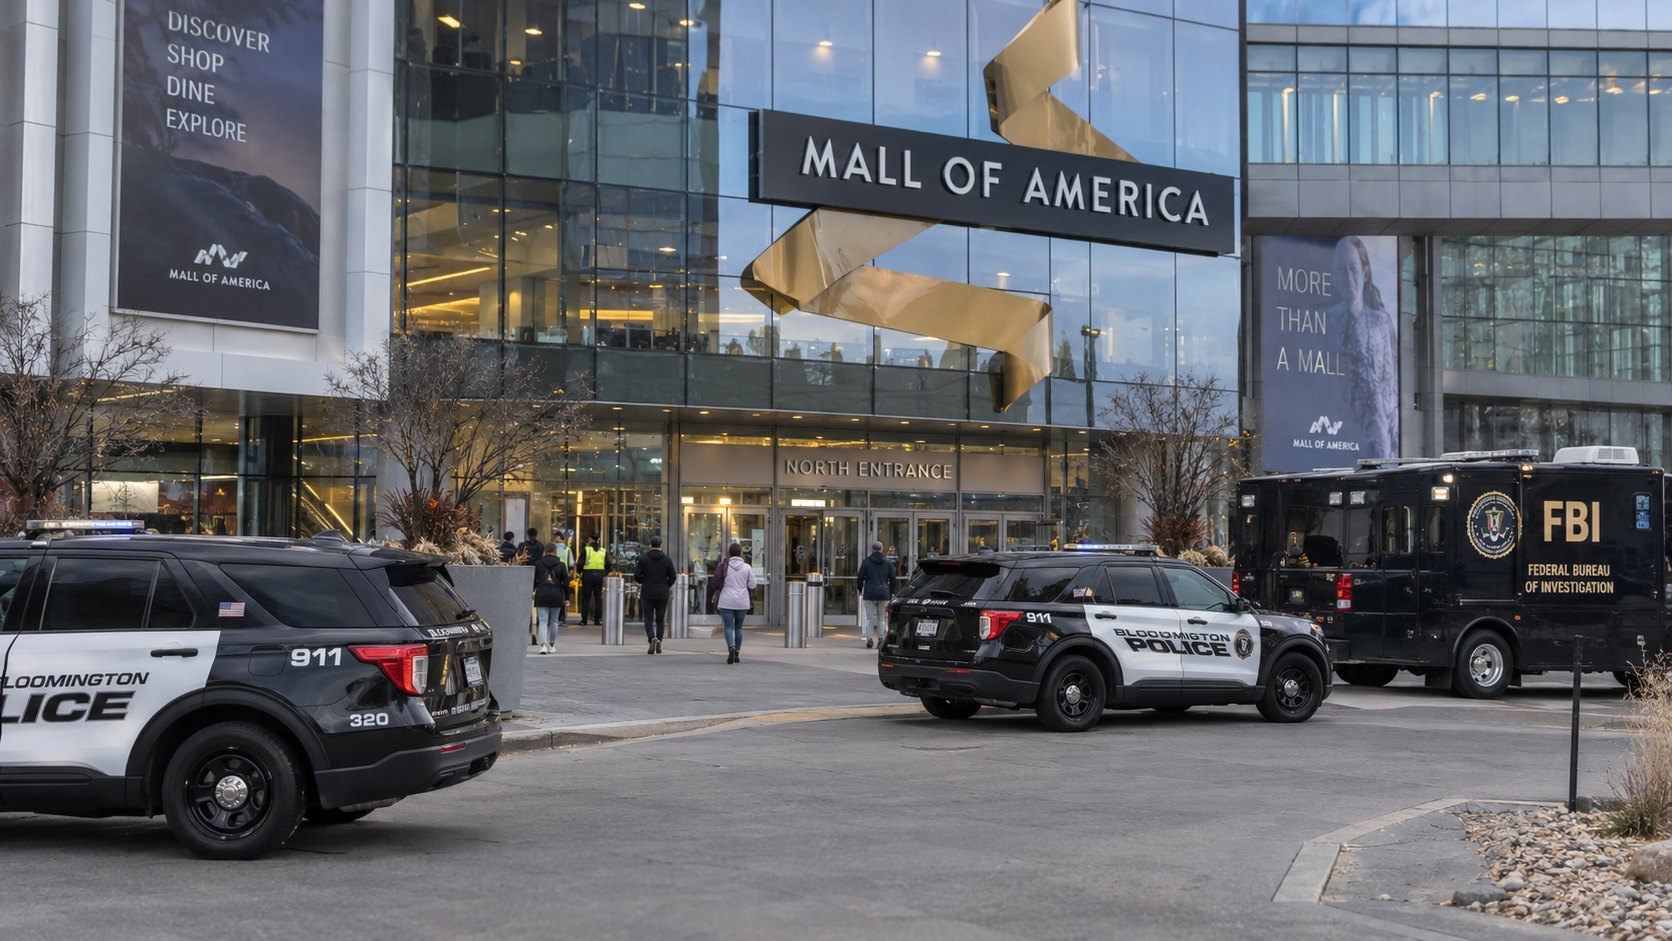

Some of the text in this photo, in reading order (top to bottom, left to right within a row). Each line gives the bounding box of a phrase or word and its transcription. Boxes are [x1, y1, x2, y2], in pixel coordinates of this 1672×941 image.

[168, 10, 270, 53] DISCOVER
[167, 43, 224, 73] SHOP
[167, 75, 215, 105] DINE
[166, 107, 247, 143] EXPLORE
[801, 135, 1209, 226] MALL OF AMERICA
[169, 268, 271, 291] MALL OF AMERICA
[1277, 266, 1332, 297] MORE
[1276, 306, 1327, 336] THAN
[1276, 346, 1346, 376] A MALL
[1292, 438, 1360, 451] MALL OF AMERICA
[785, 459, 952, 479] NORTH ENTRANCE
[1543, 500, 1600, 542] FBI
[1528, 564, 1610, 577] FEDERAL BUREAU
[1525, 581, 1614, 594] OF INVESTIGATION
[1026, 612, 1052, 623] 911
[290, 647, 342, 667] 911
[1124, 638, 1231, 657] POLICE
[0, 672, 150, 688] LOOMINGTON
[350, 712, 389, 727] 320
